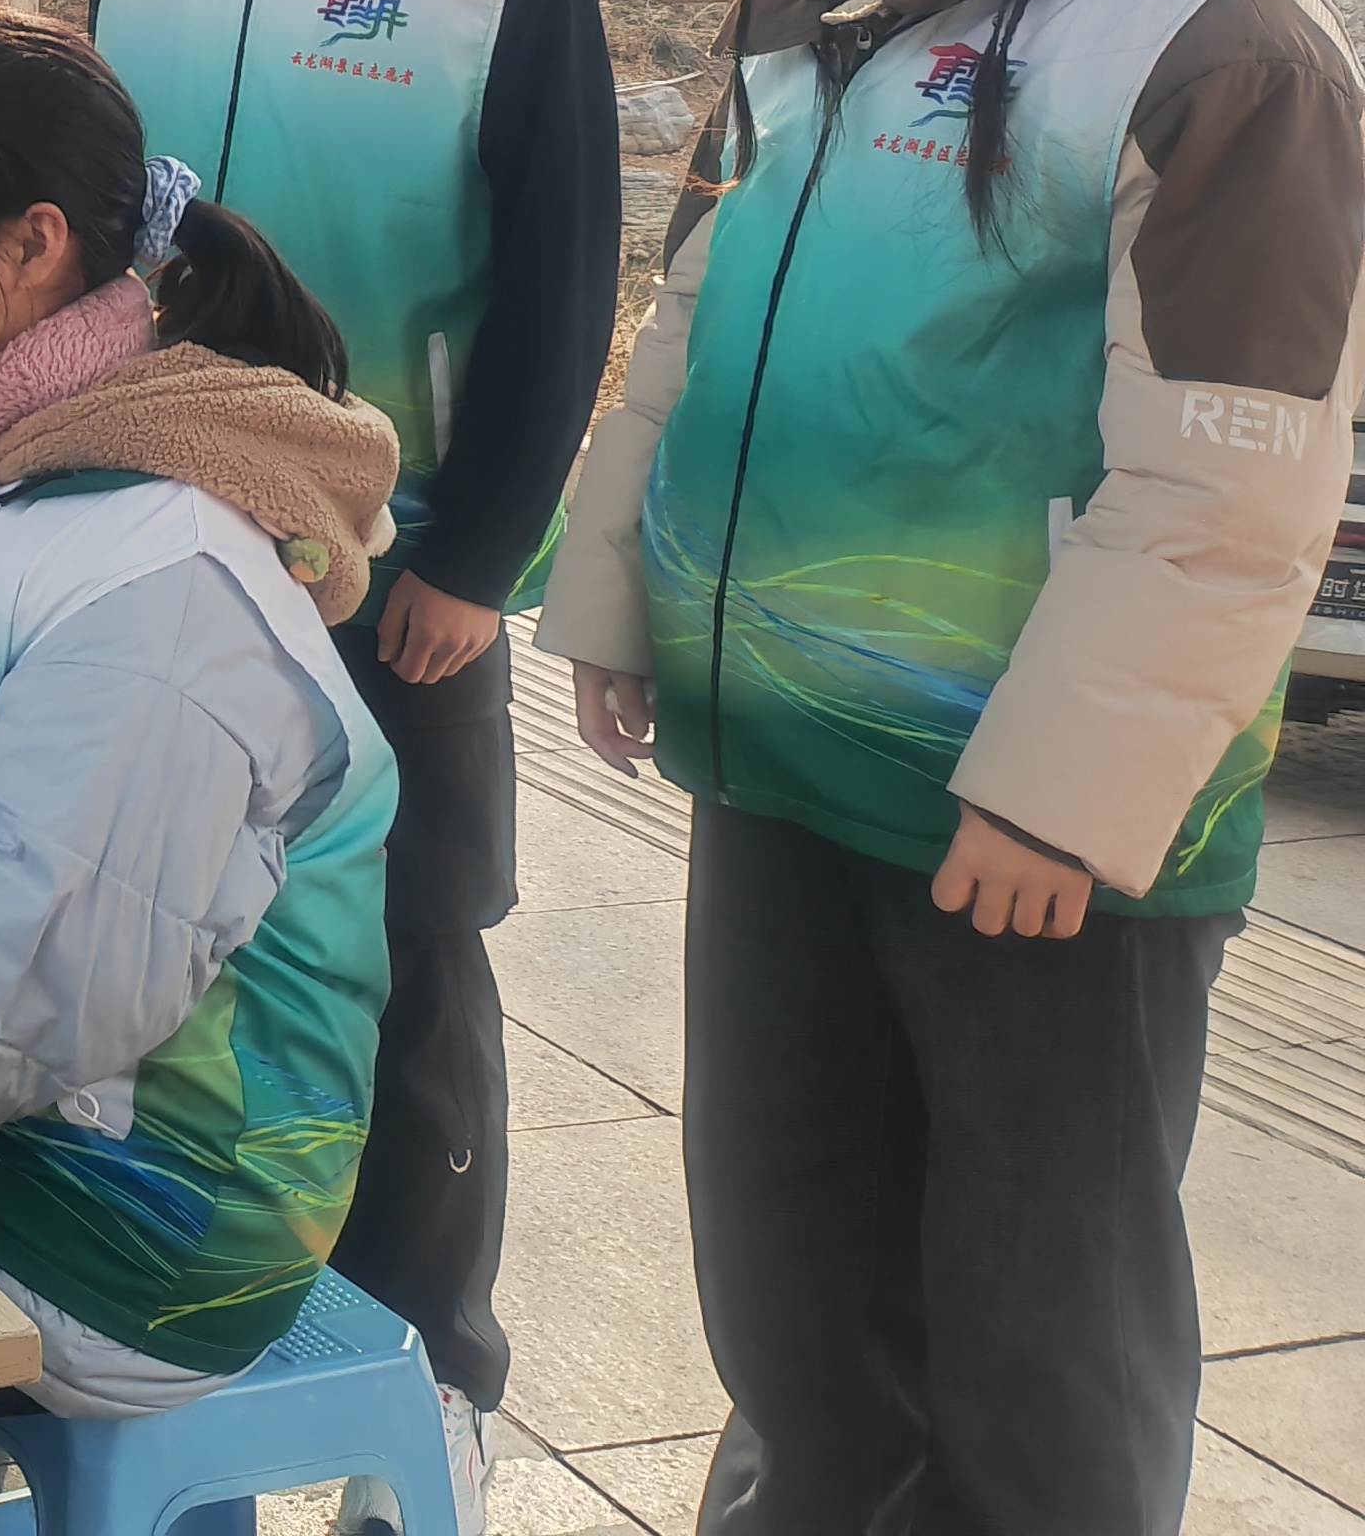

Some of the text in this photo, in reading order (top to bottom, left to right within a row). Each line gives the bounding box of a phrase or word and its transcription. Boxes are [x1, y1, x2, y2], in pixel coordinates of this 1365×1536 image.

[290, 50, 415, 87] 云龙湖景区志愿者
[1179, 389, 1308, 461] REN
